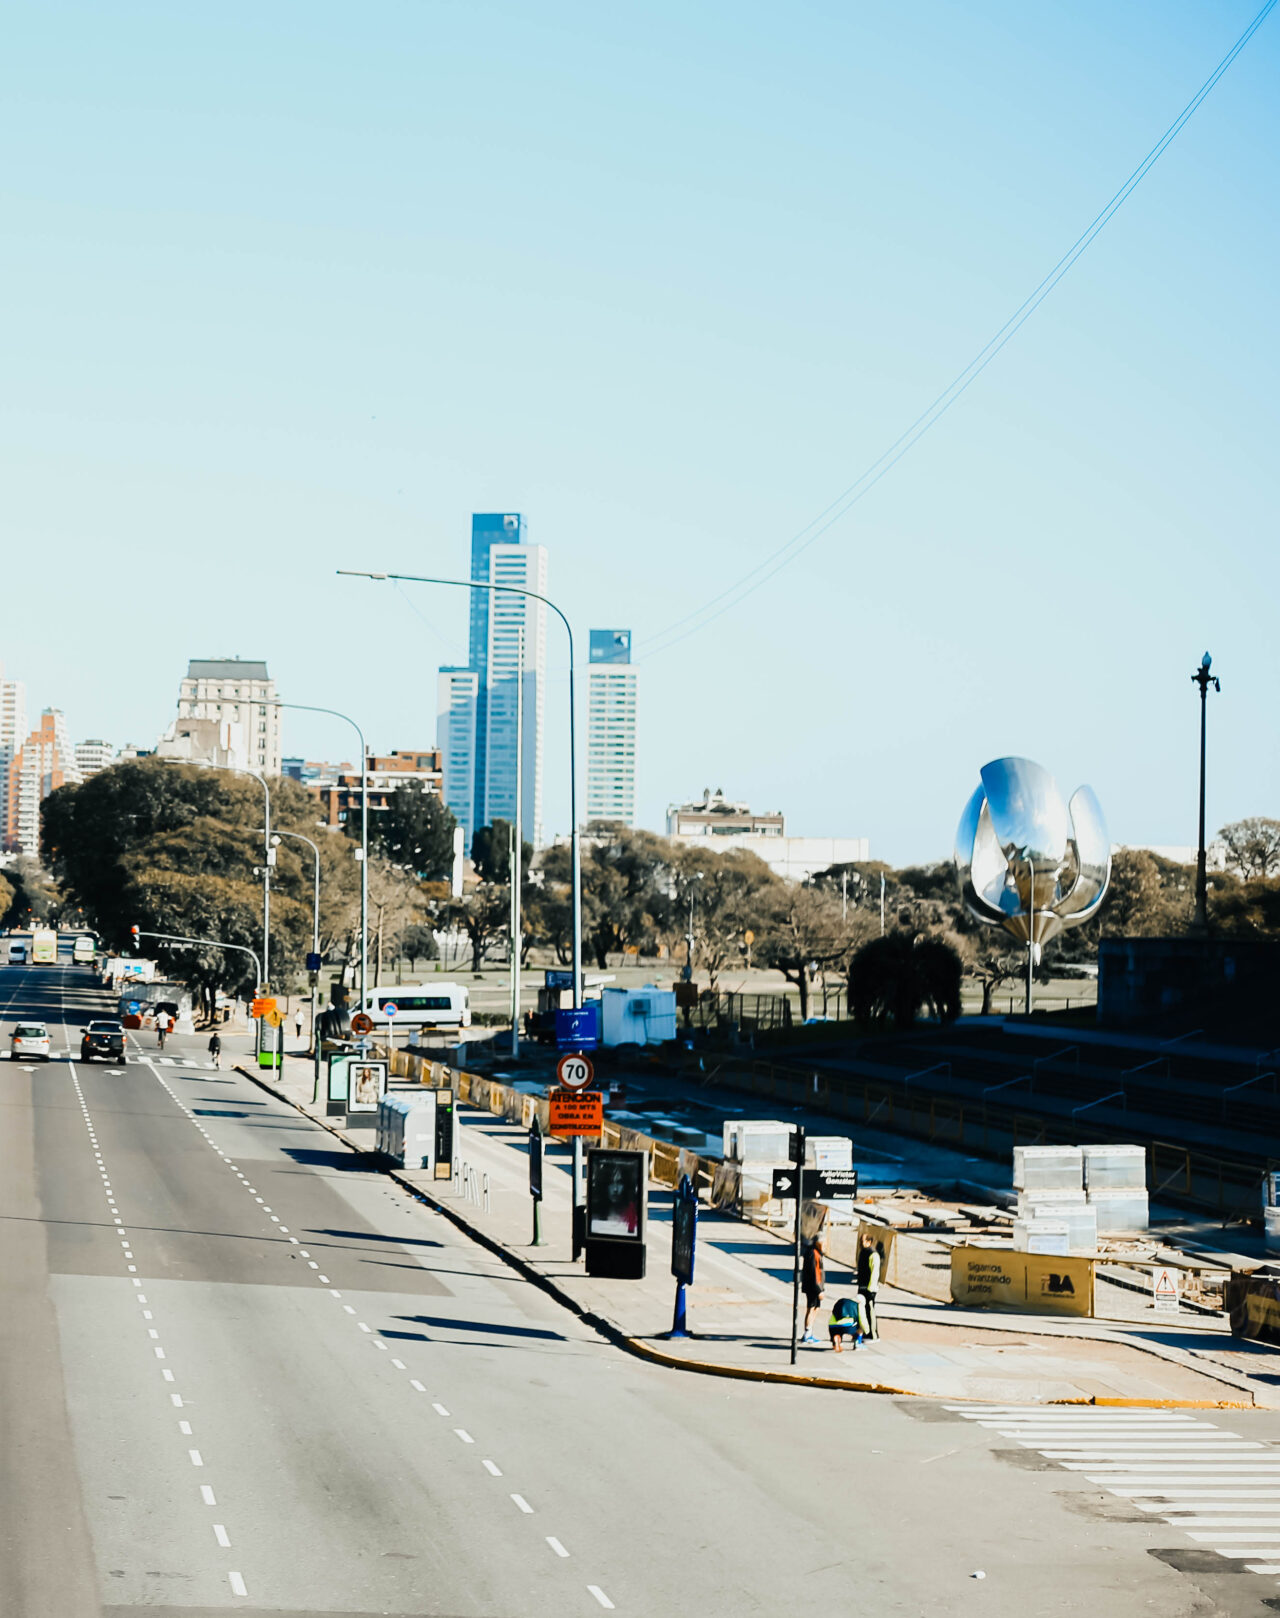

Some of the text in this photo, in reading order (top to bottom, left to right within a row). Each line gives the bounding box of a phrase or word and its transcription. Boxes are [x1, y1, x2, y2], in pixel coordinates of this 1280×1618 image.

[566, 1064, 586, 1079] 70
[967, 1262, 1002, 1273] Sigamos
[967, 1274, 1012, 1285] avanzando
[1049, 1273, 1075, 1294] BA
[967, 1285, 993, 1295] juntos
